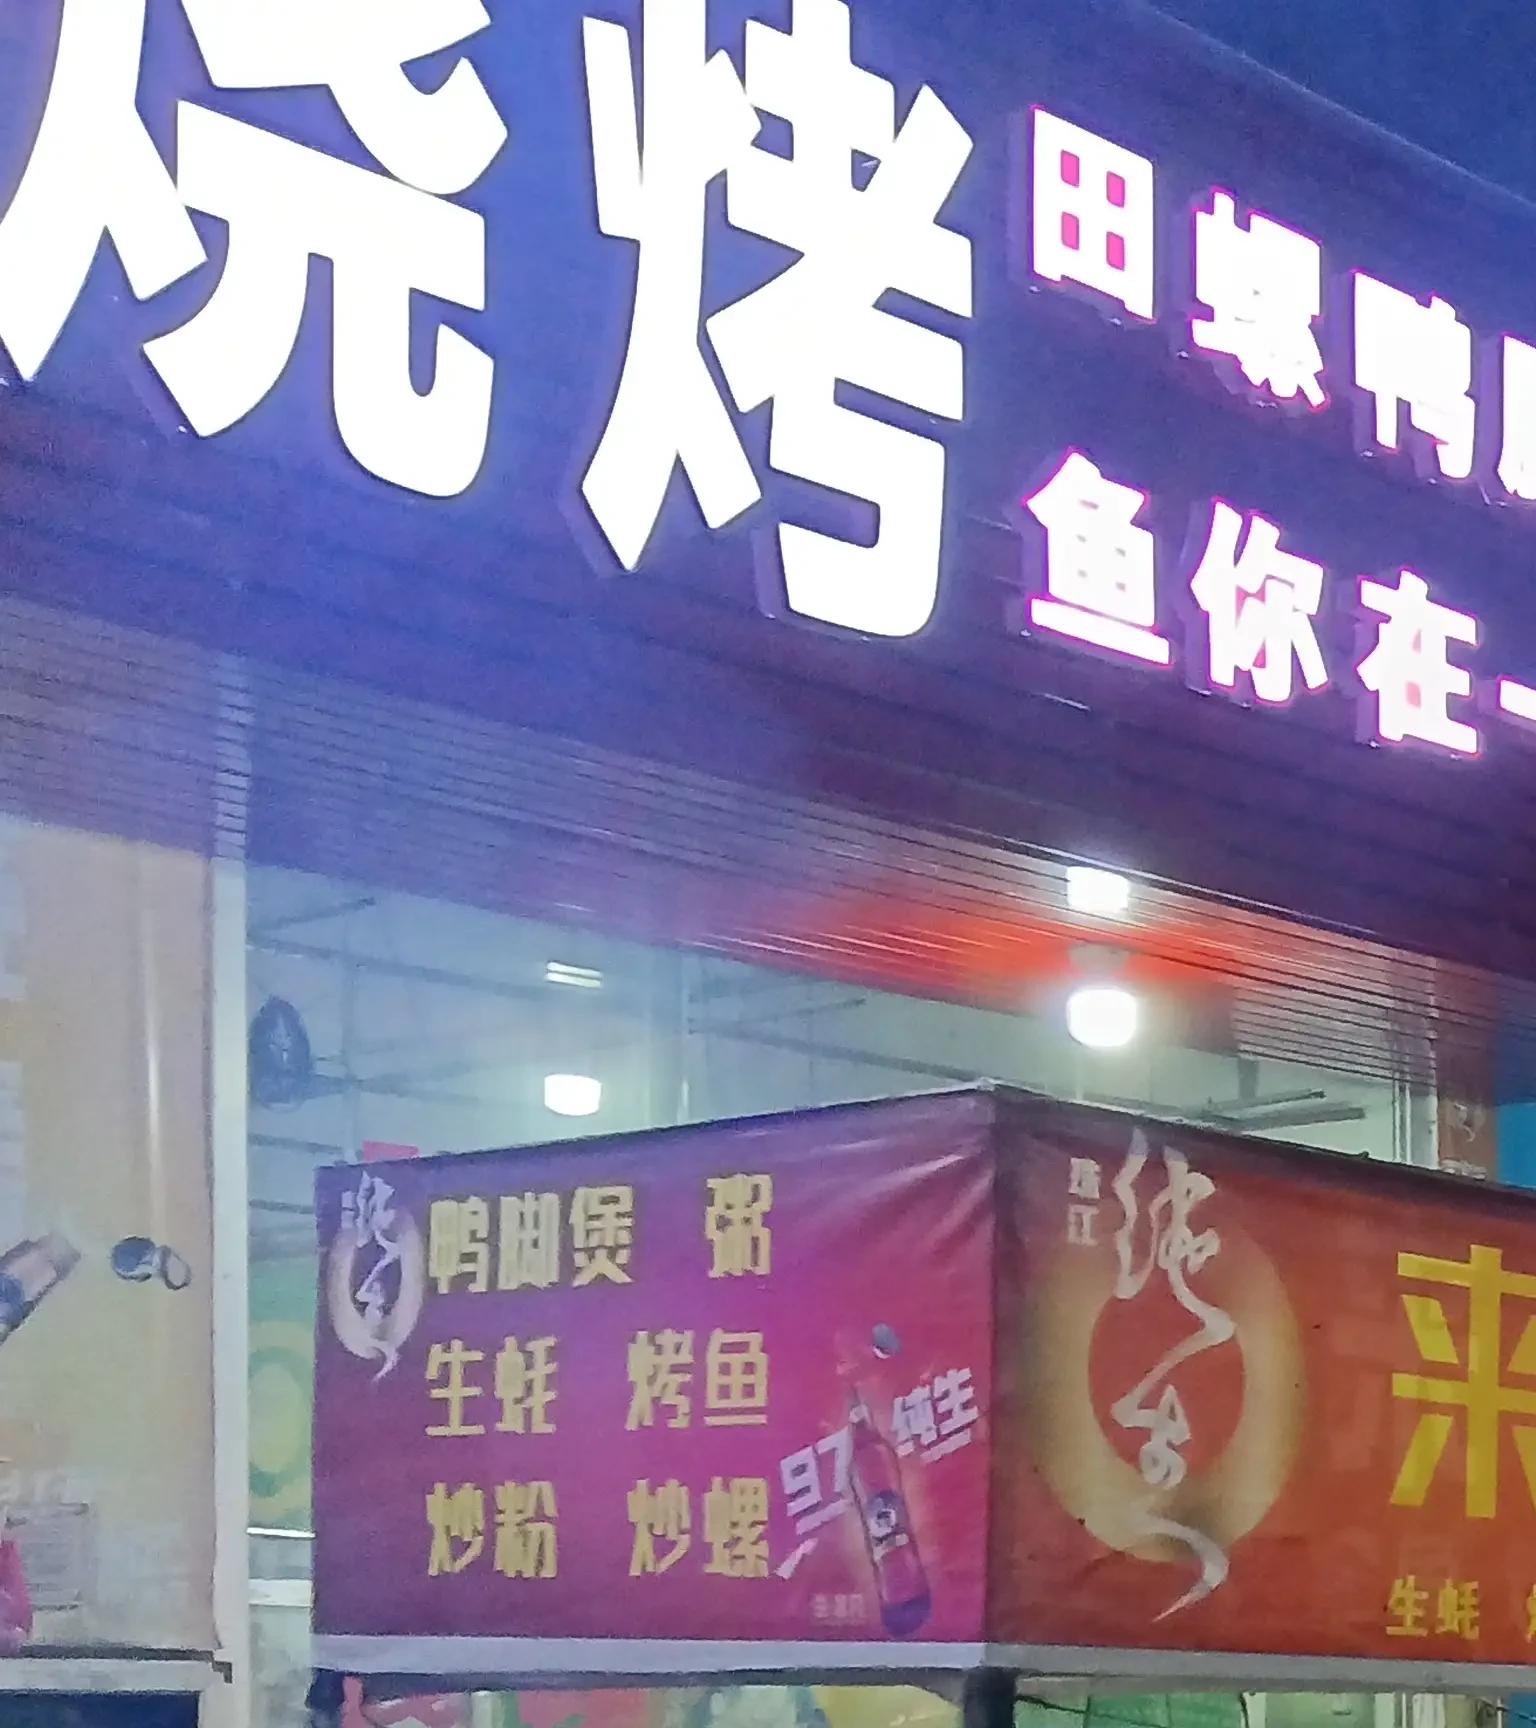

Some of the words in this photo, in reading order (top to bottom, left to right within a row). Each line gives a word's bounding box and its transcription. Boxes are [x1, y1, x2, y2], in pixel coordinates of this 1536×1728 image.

[0, 0, 976, 638] 烧烤
[427, 1185, 634, 1294] 鸭脚煲
[704, 1173, 773, 1278] 粥
[425, 1336, 559, 1437] 生蚝
[624, 1328, 771, 1430] 烤鱼
[426, 1479, 559, 1579] 炒粉
[626, 1476, 771, 1578] 炒螺
[1385, 1575, 1480, 1639] 生蚝
